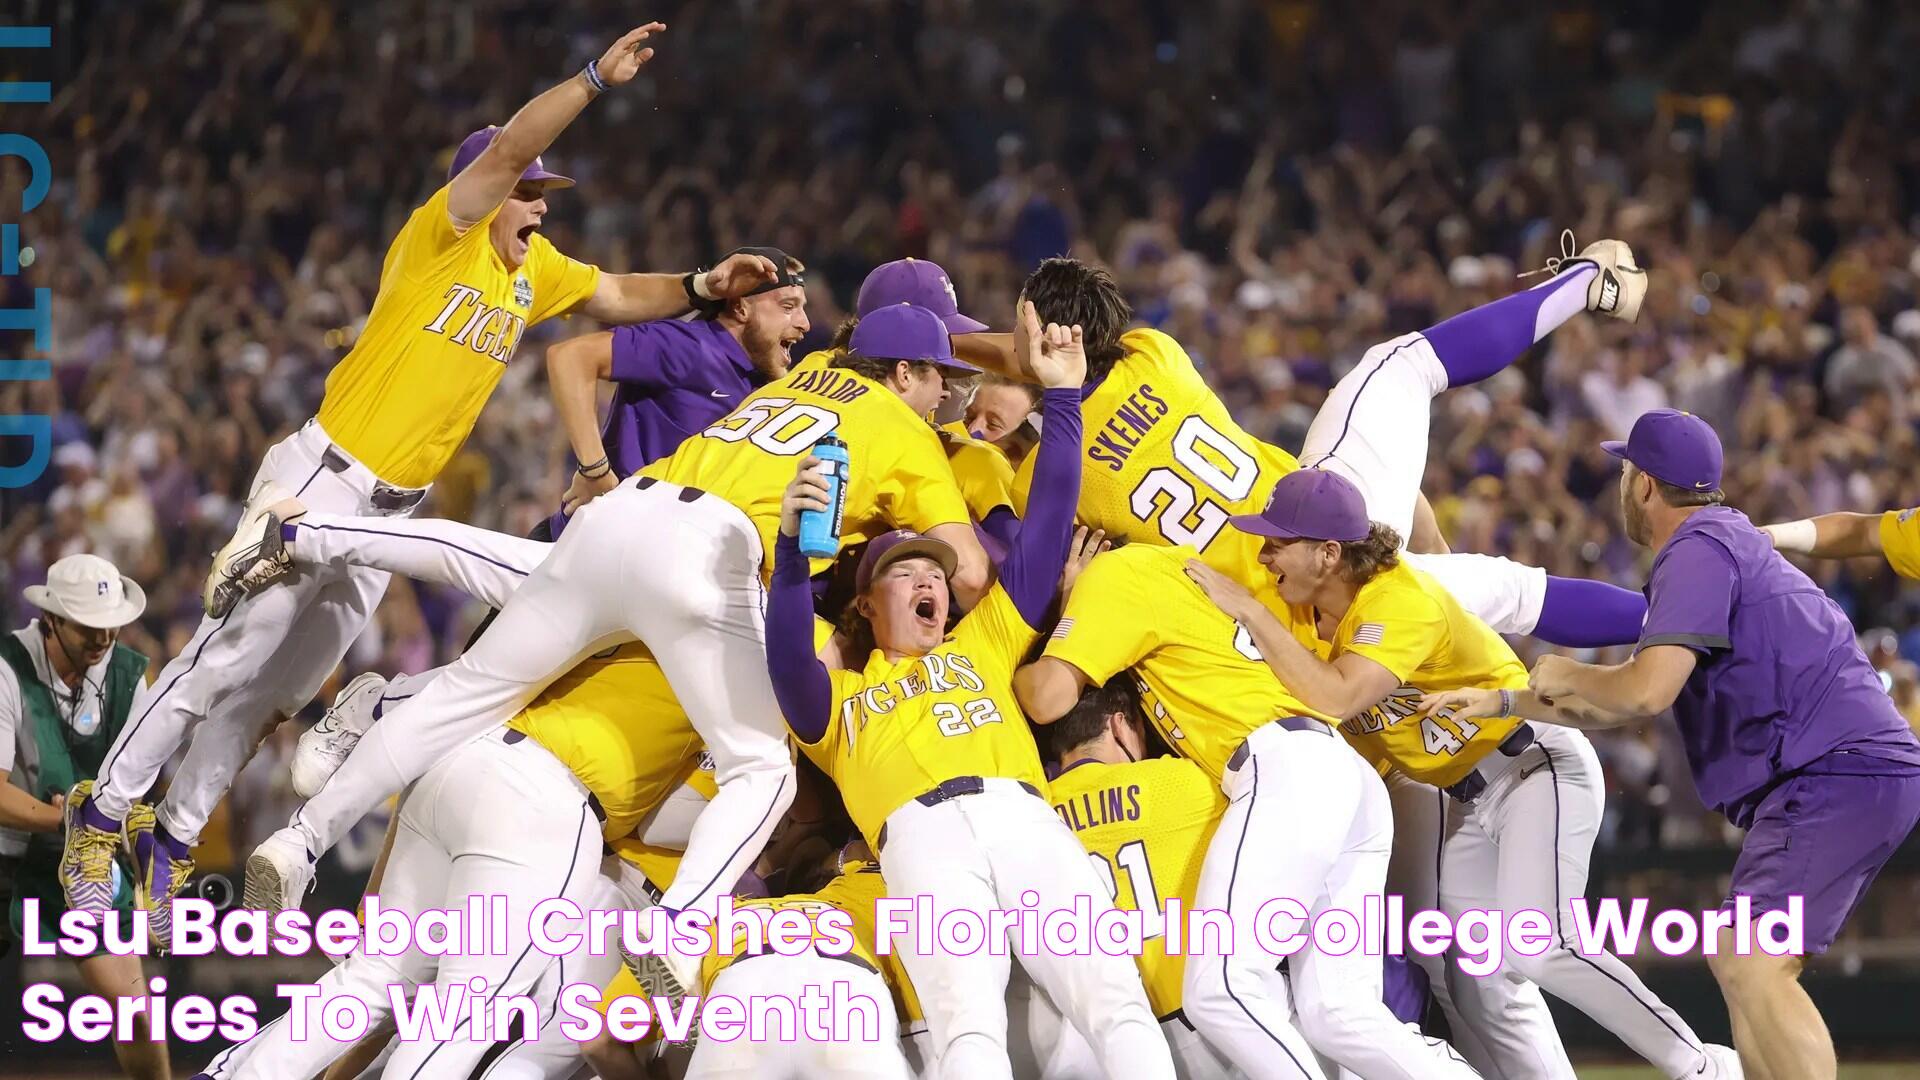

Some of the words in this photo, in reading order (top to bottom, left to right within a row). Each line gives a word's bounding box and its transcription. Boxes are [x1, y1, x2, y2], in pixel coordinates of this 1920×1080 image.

[787, 369, 870, 404] TAYLOR
[701, 397, 841, 456] 50
[1088, 384, 1169, 472] SKENES
[1129, 414, 1260, 555] 20
[932, 697, 1004, 738] 22
[1419, 705, 1481, 756] 41
